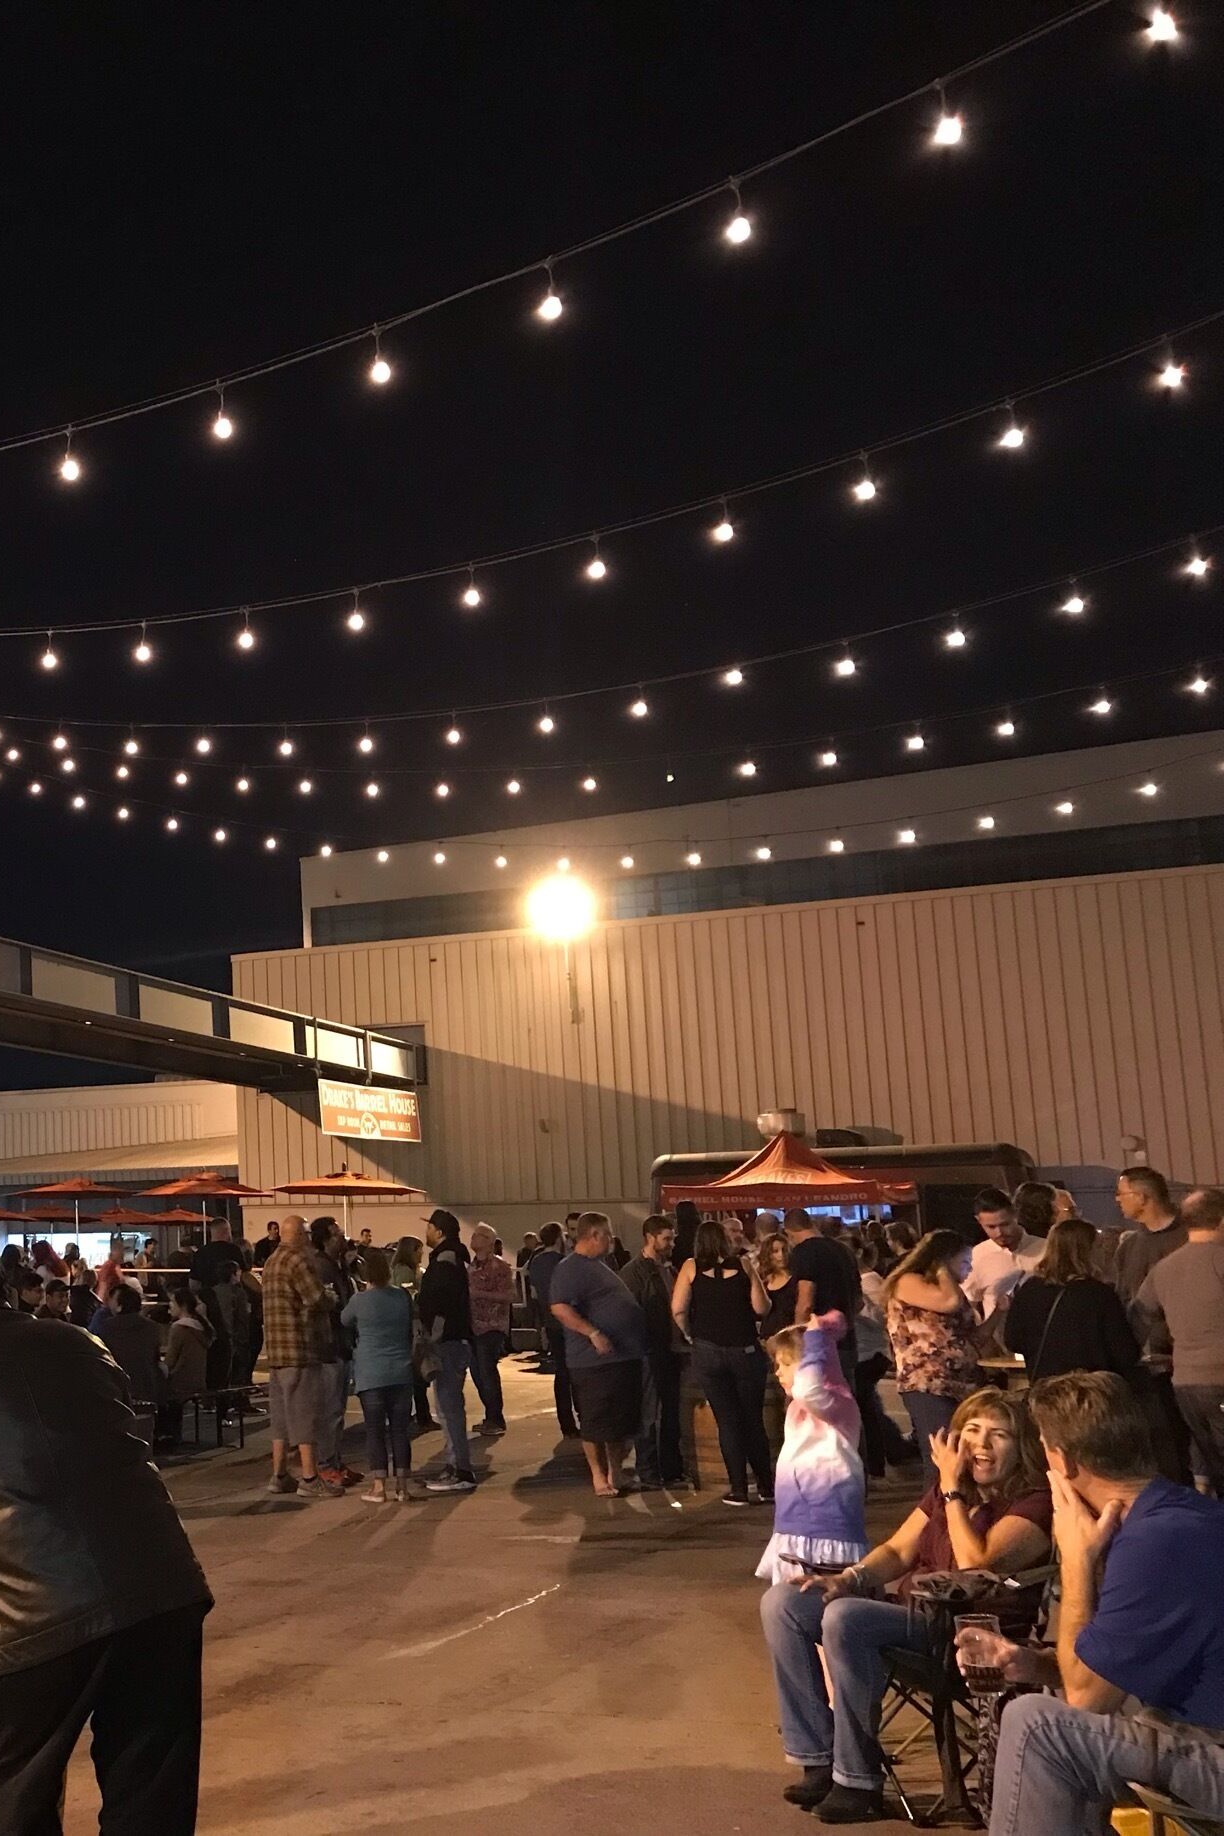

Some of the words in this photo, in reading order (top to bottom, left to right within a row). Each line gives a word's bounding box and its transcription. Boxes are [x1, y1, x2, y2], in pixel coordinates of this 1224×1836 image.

[389, 1093, 416, 1116] HOUSE
[721, 1195, 765, 1204] HOUSE
[805, 1192, 869, 1202] LEANDRO
